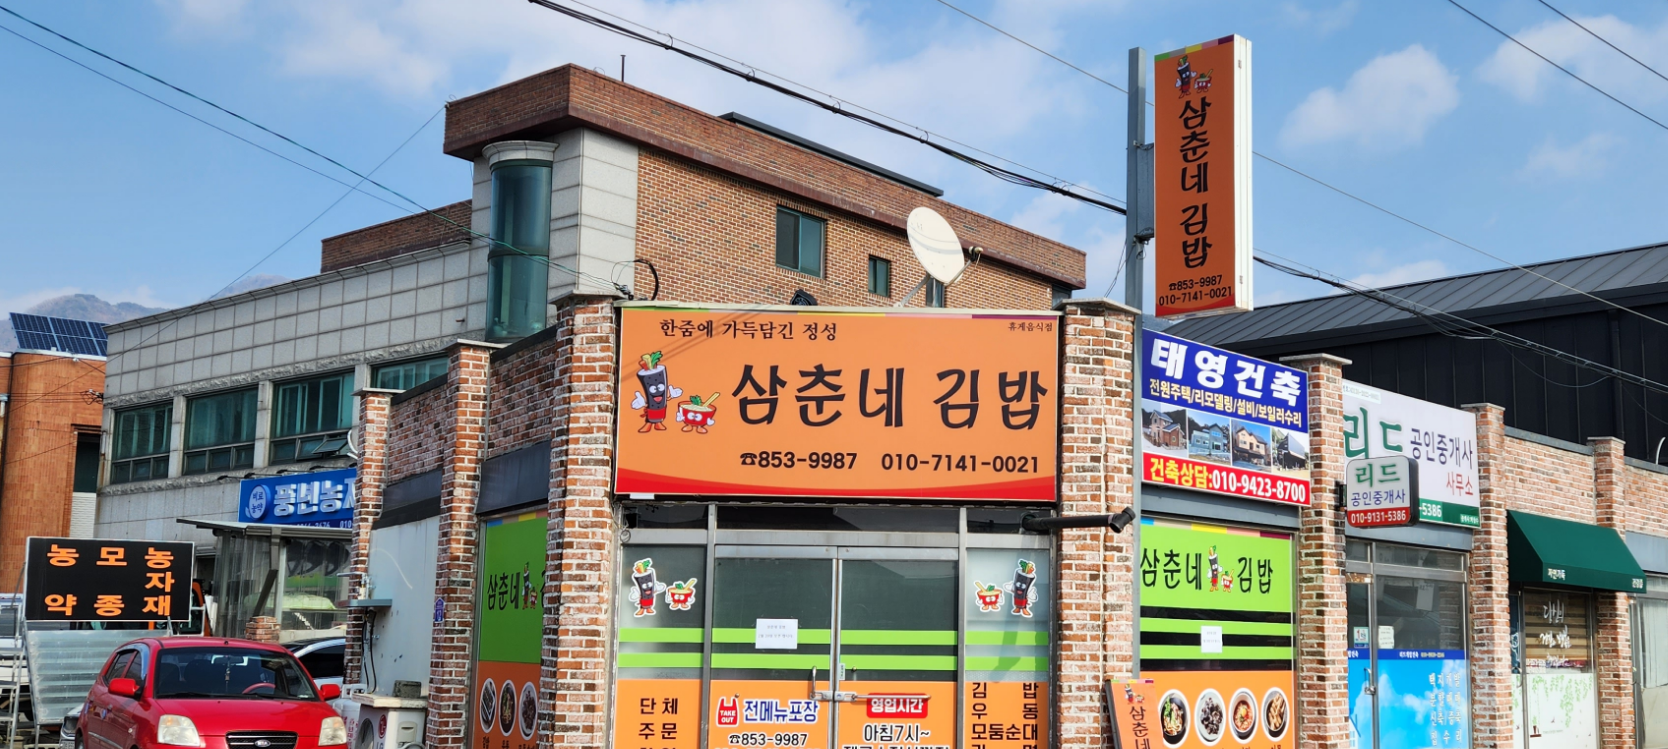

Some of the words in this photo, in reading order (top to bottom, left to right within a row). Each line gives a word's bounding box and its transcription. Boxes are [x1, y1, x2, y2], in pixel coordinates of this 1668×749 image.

[1178, 96, 1212, 194] 삼춘네
[1179, 203, 1213, 269] 김밥
[1176, 275, 1223, 291] 853-9987
[1158, 286, 1232, 306] 010-7141-0021
[660, 318, 714, 338] 한줌에
[722, 320, 794, 340] 가득담긴
[802, 322, 837, 341] 정성
[1007, 321, 1054, 332] 휴게음식점
[1150, 338, 1302, 407] 태영건축
[731, 362, 905, 428] 삼춘네
[932, 367, 1048, 431] 김밥
[1410, 427, 1474, 470] 공인중개사
[758, 450, 858, 470] 853-9987
[881, 453, 1039, 474] 010-7141-0021
[1355, 463, 1401, 488] 리드
[1446, 471, 1474, 497] 사무소
[1350, 488, 1406, 507] 공인중개사
[1350, 510, 1407, 524] 010-9131-5386
[1140, 547, 1202, 590] 삼춘네
[1237, 556, 1273, 594] 김밥
[486, 571, 521, 611] 삼춘네
[720, 709, 736, 717] TAKE
[721, 716, 734, 724] OUT
[744, 700, 819, 723] 전메뉴포장
[741, 733, 808, 746] 853-9987
[971, 723, 1039, 741] 모둠순대
